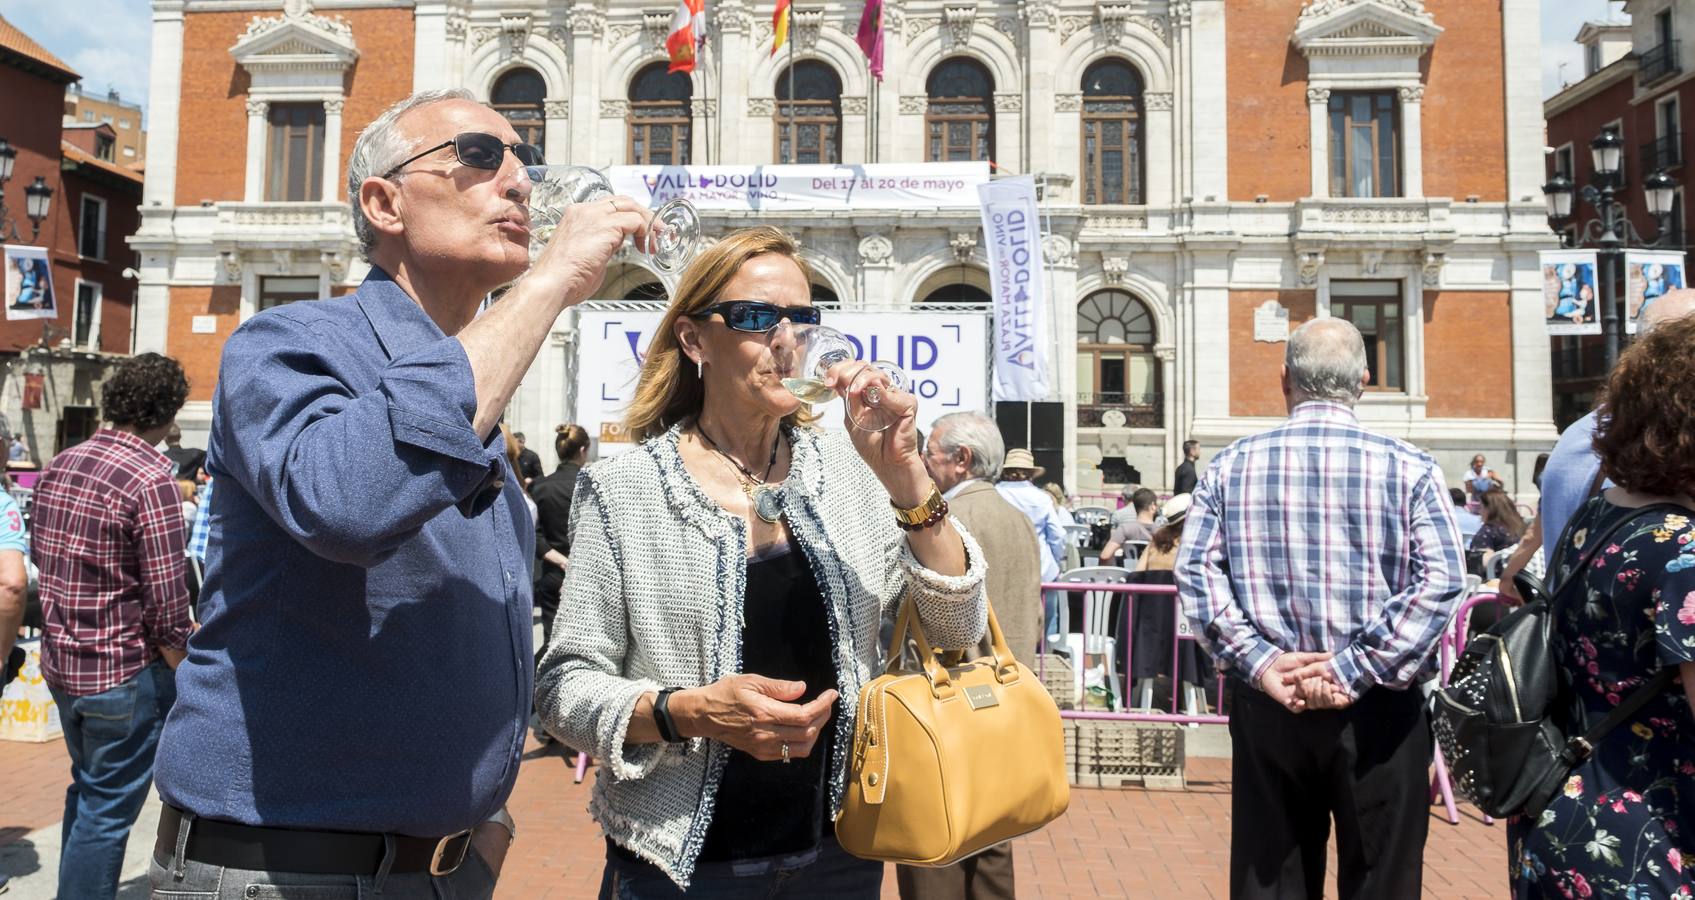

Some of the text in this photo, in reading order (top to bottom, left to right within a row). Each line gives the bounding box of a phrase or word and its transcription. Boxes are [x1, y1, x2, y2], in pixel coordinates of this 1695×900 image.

[812, 177, 964, 194] Del 17 al 20 de mayo
[749, 191, 778, 200] VINO
[7, 511, 21, 531] 3
[1179, 623, 1191, 634] 9
